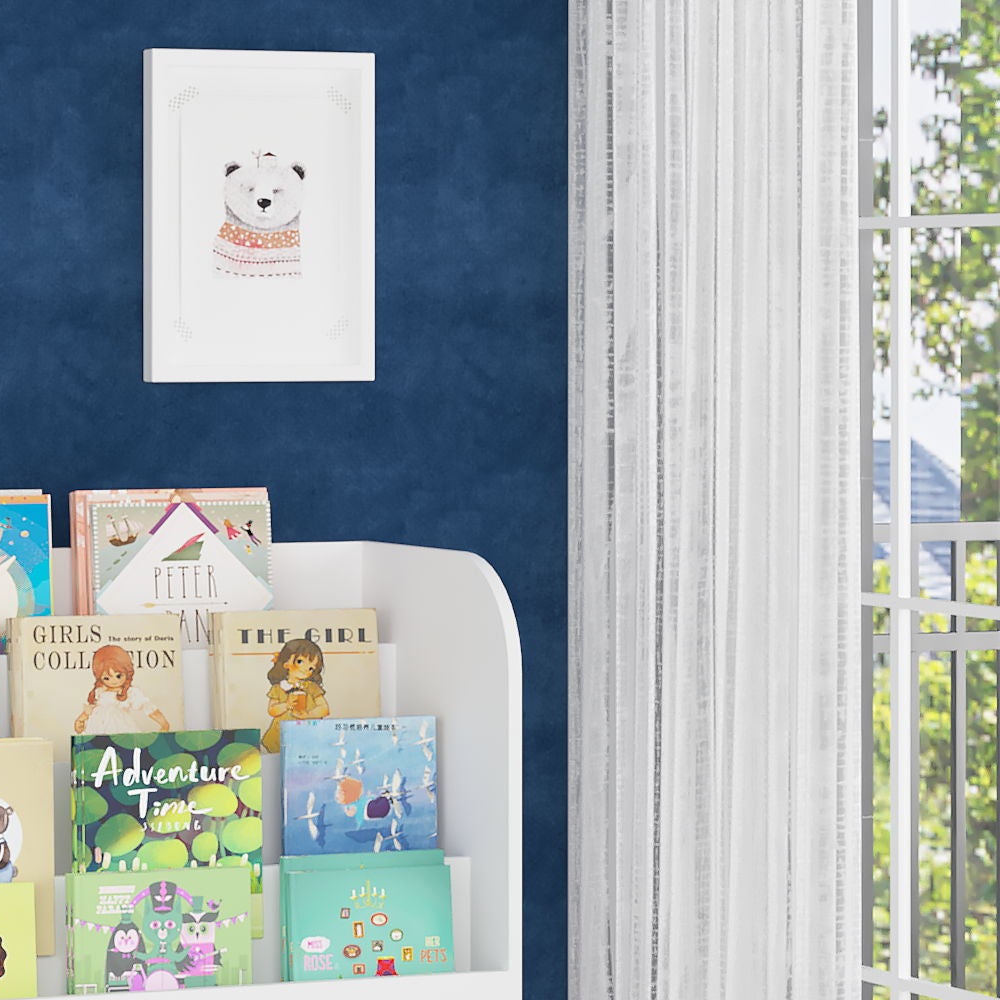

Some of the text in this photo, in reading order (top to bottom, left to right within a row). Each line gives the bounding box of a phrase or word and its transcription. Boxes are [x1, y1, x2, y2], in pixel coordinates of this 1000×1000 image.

[153, 565, 218, 599] PETER
[33, 624, 102, 644] GIRLS
[165, 608, 212, 645] AN
[236, 627, 372, 644] THE GIRL
[91, 746, 251, 789] Adventure
[127, 787, 214, 819] Time
[303, 953, 335, 972] ROSE
[420, 948, 447, 963] PETS
